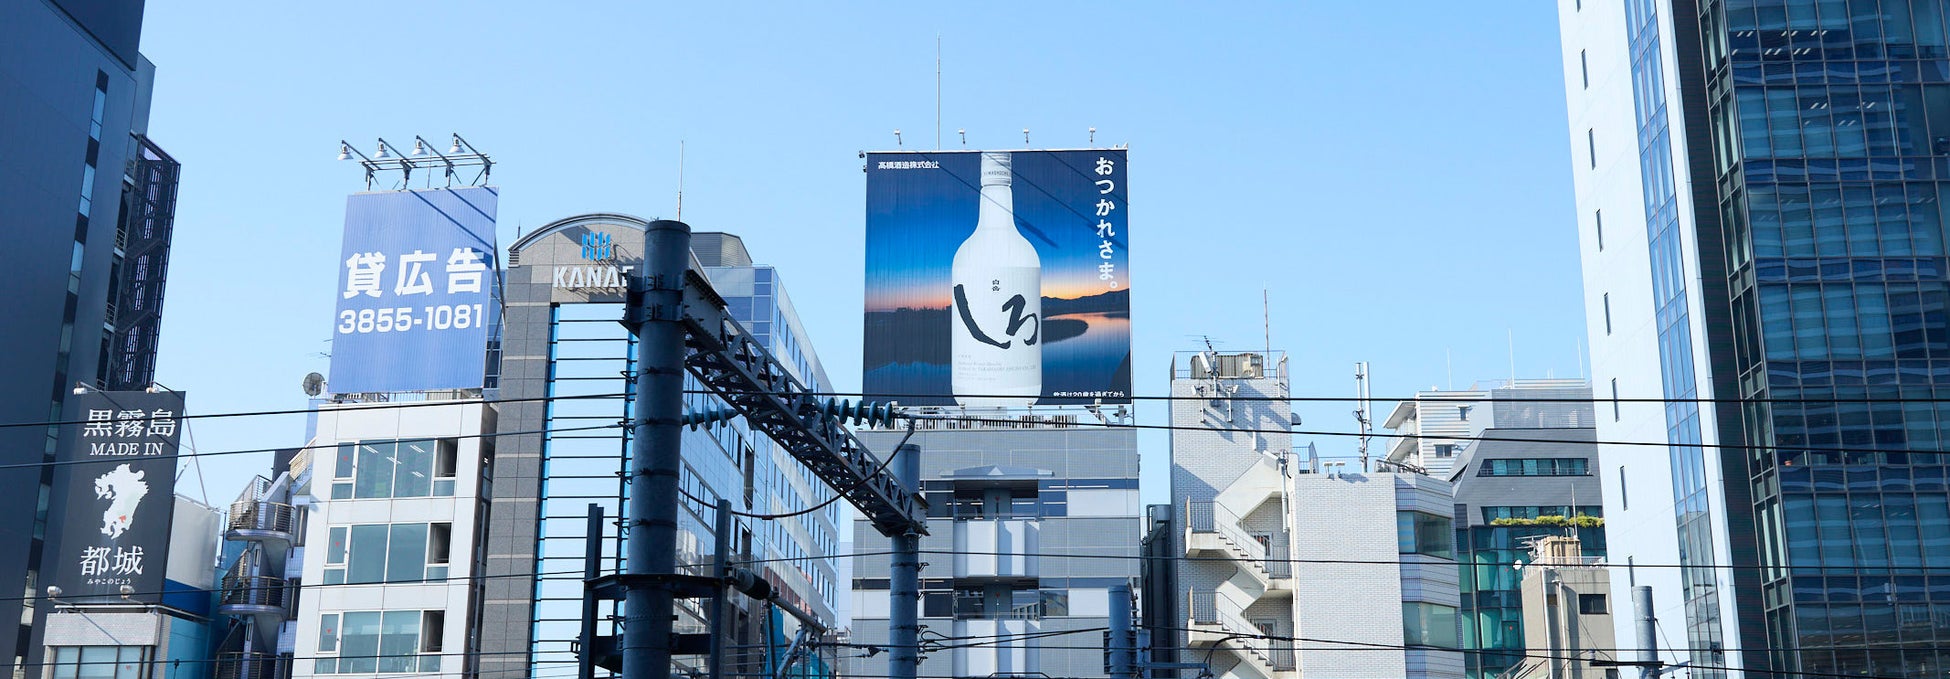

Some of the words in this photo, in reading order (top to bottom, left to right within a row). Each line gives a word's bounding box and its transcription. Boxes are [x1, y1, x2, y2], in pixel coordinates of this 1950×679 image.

[1094, 156, 1118, 288] おつかれさま。
[343, 247, 486, 299] 貸広告
[338, 303, 483, 334] 3855-1081
[953, 283, 1038, 350] しろ
[83, 408, 177, 437] 黒霧島
[89, 442, 140, 456] MADE
[142, 442, 164, 456] IN
[80, 545, 144, 576] 都城
